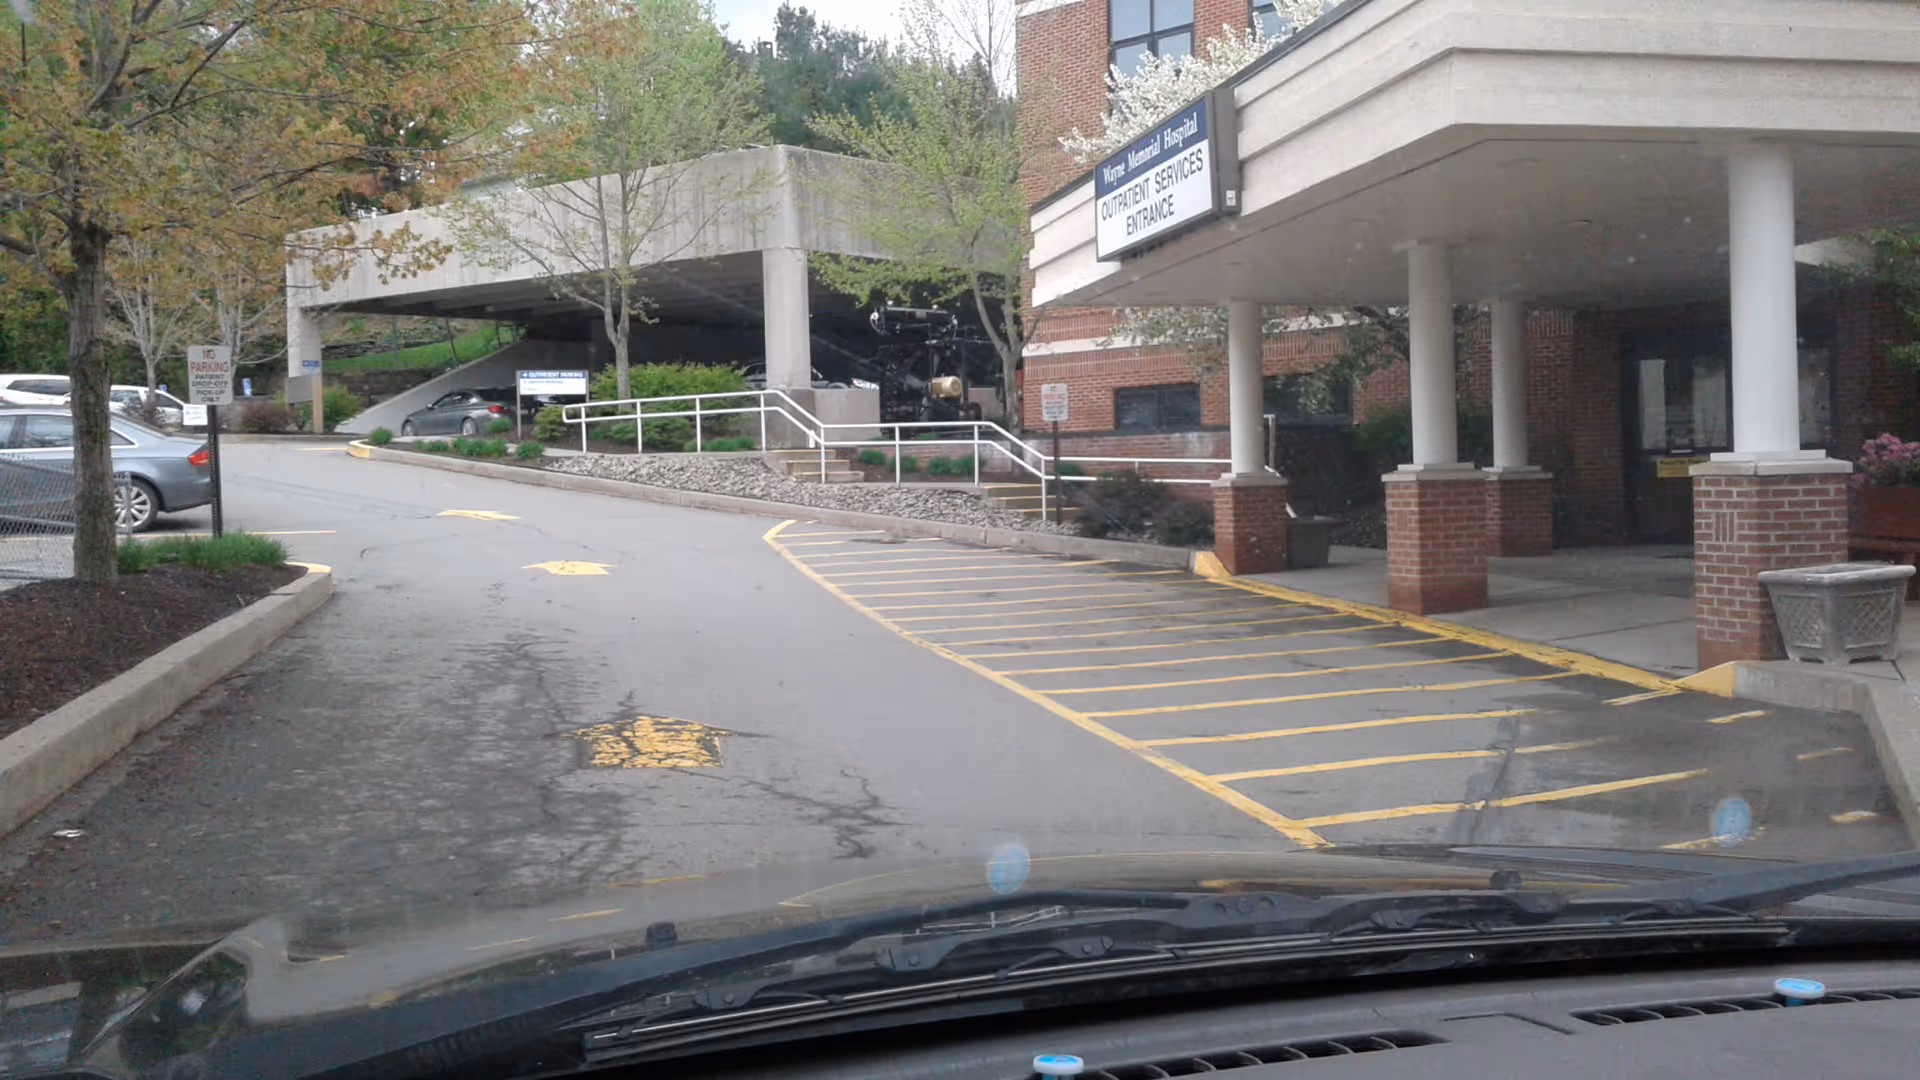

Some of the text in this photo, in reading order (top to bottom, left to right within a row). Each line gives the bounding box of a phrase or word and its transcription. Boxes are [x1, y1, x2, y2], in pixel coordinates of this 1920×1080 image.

[1103, 111, 1198, 186] Wayne Memorial Hospital
[1101, 148, 1203, 221] OUTPATIENT SERVICES
[1126, 194, 1174, 236] ENTRANCE
[190, 361, 229, 373] PARKING
[203, 349, 216, 360] NO
